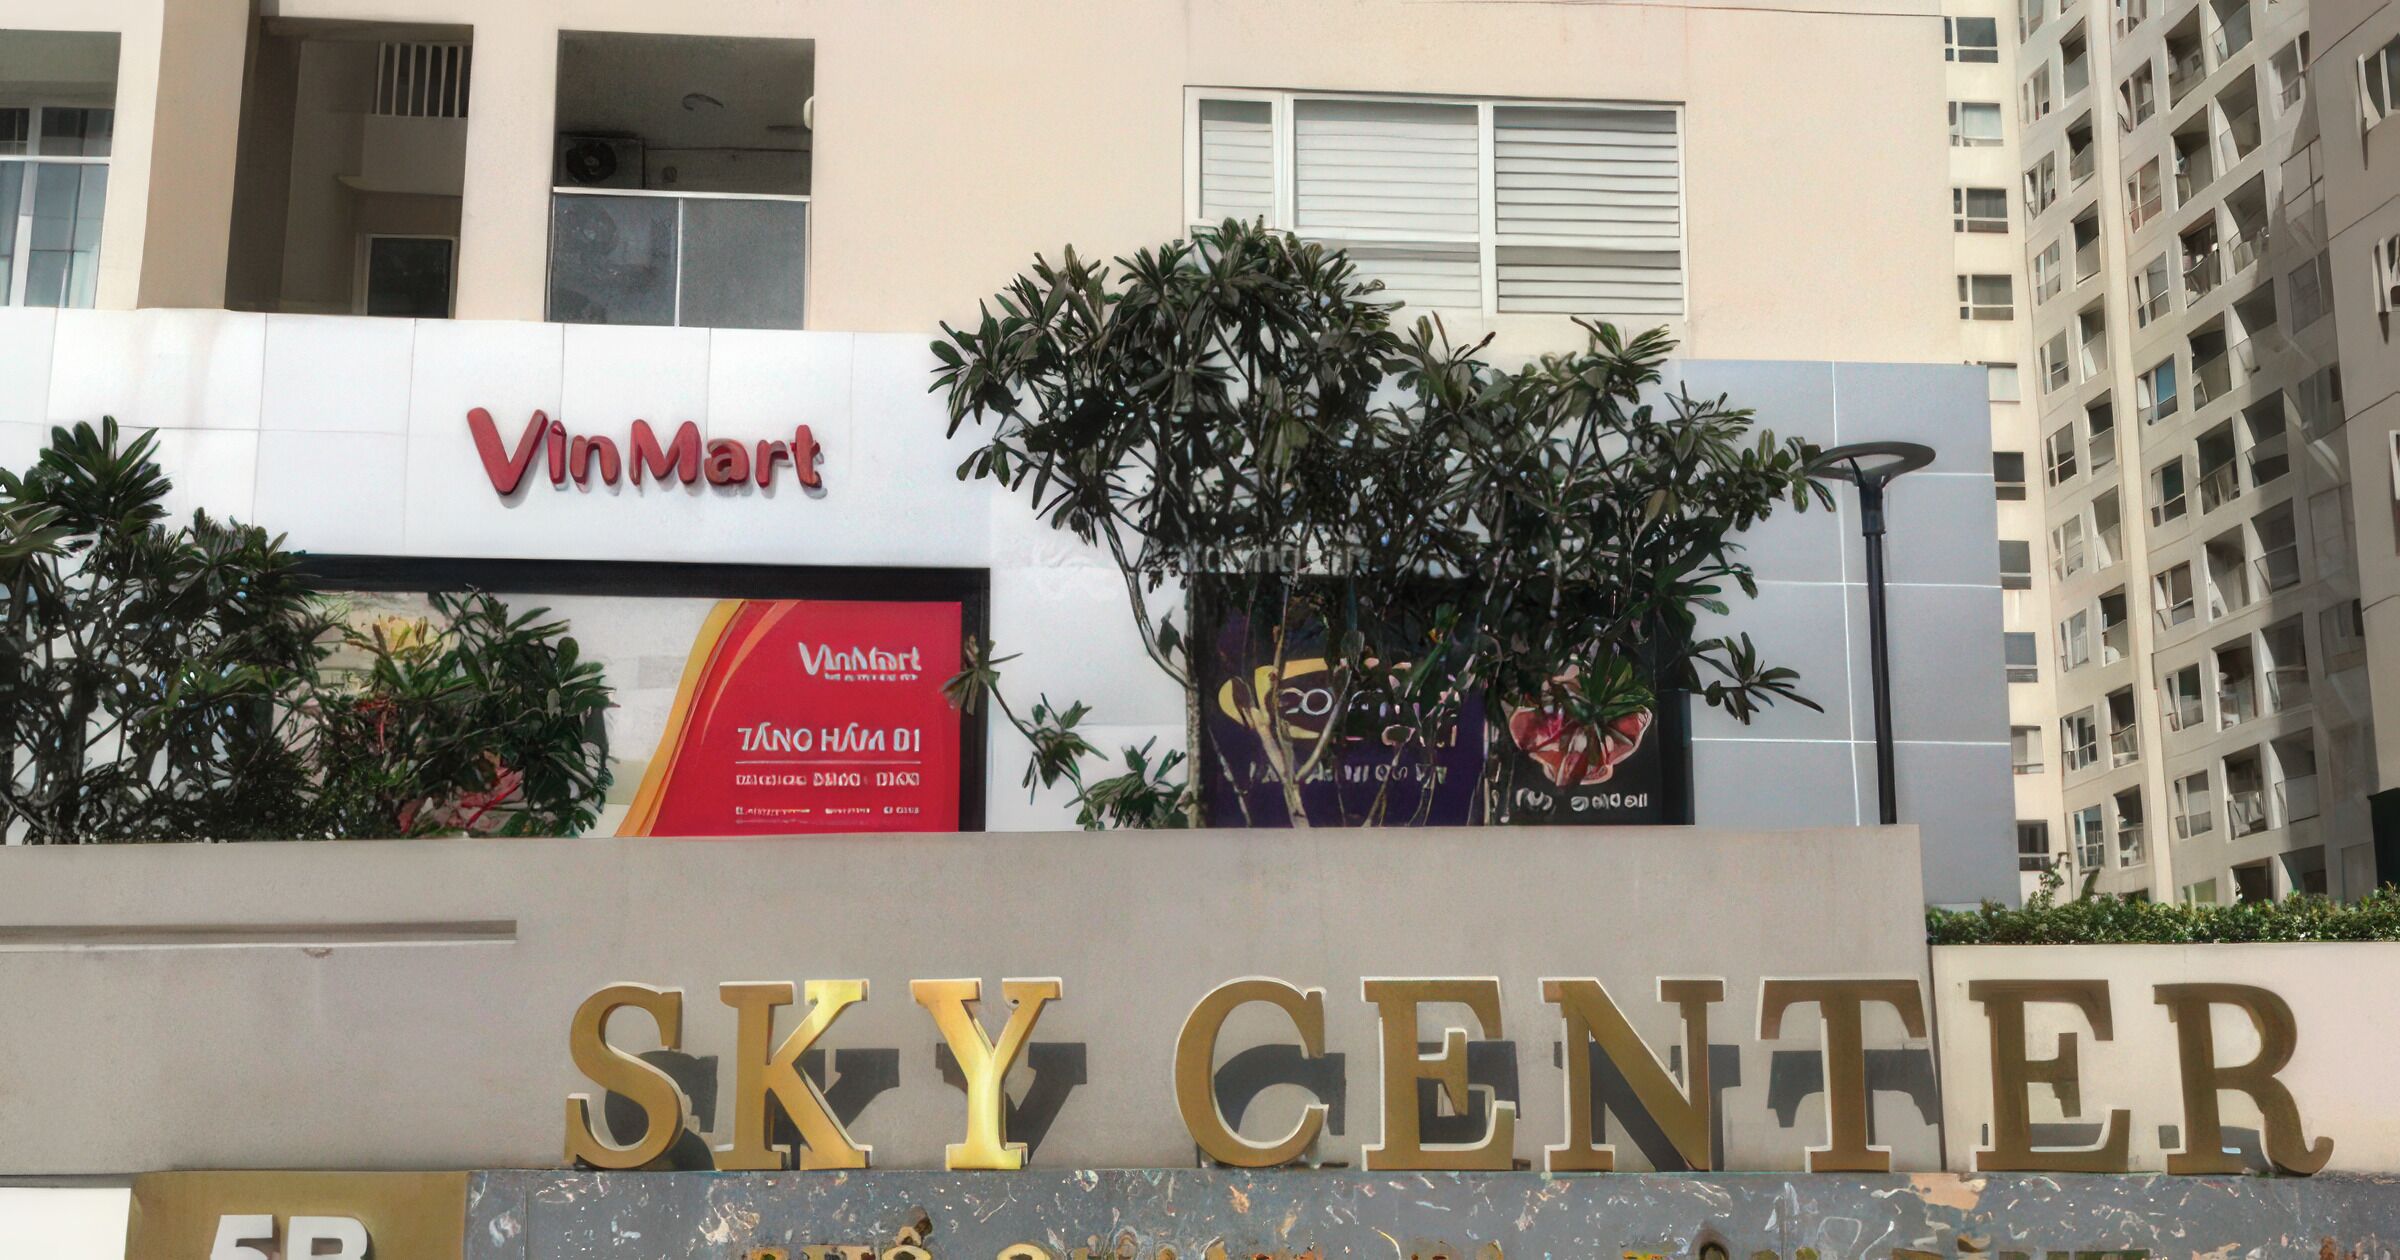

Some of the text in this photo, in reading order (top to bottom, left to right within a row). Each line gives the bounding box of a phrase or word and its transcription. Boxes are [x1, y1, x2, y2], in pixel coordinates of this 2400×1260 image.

[467, 408, 822, 496] VinMart
[564, 974, 2334, 1177] SKY CENTER
